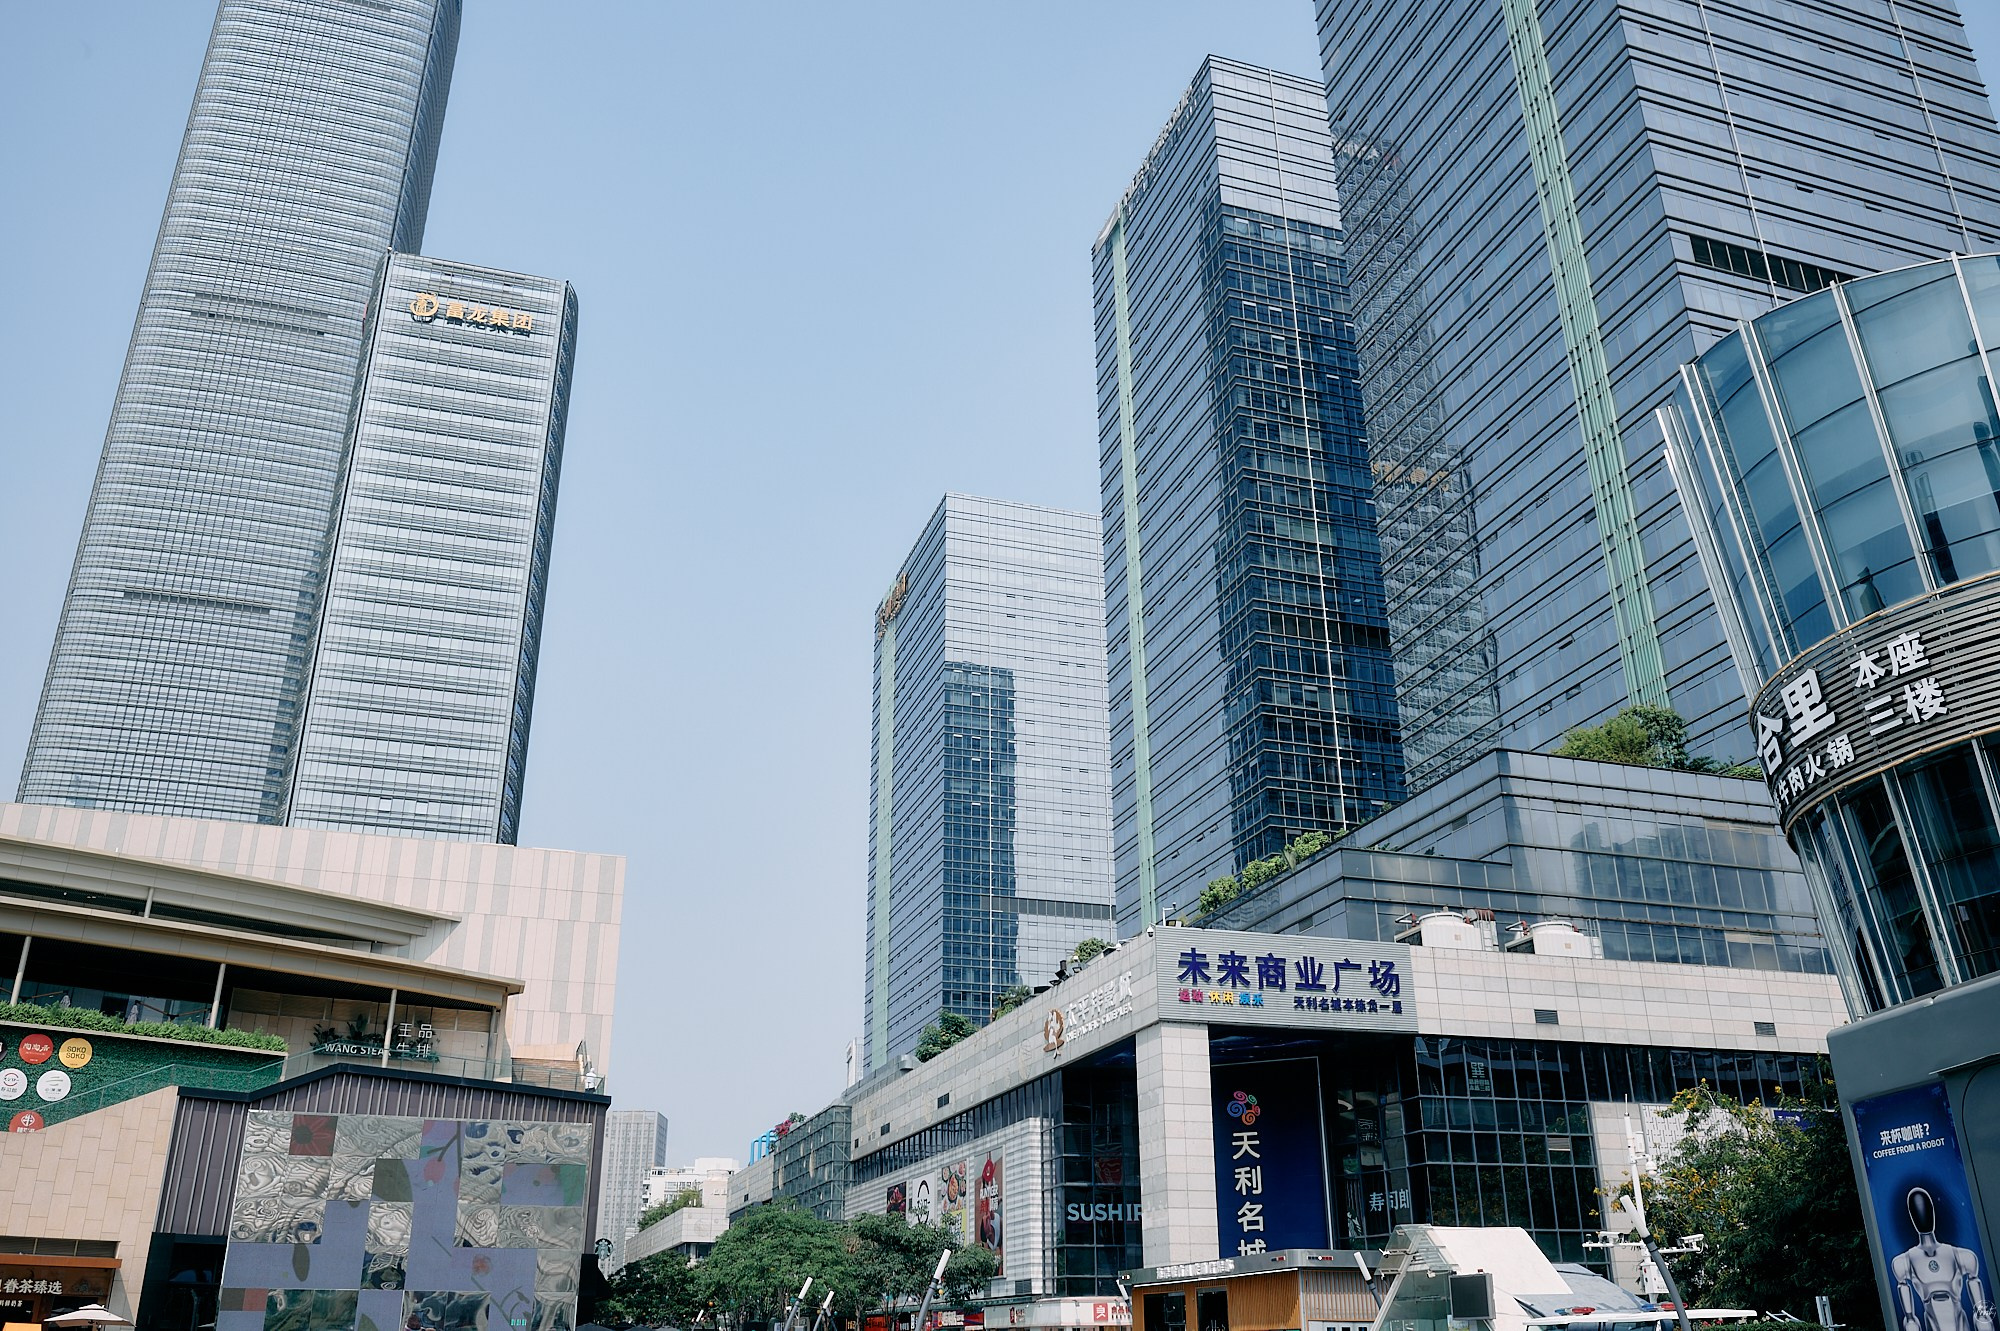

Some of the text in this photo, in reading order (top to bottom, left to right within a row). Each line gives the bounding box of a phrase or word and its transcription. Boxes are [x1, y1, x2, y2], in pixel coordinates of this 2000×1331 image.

[446, 301, 533, 331] 富龙集团
[1850, 630, 1930, 689] 本座
[1864, 676, 1948, 736] 三楼
[1177, 947, 1402, 997] 未来商业广场
[1178, 987, 1264, 1007] 运动 休闲 娱乐
[398, 1022, 432, 1039] 王品
[325, 1043, 357, 1054] WANG
[396, 1042, 431, 1058] 牛排
[1880, 1123, 1930, 1146] 来杯咖啡?
[1873, 1138, 1945, 1159] COFFEE FROM A ROBOT
[1231, 1131, 1267, 1256] 天利名城
[1369, 1189, 1411, 1212] 寿司郎
[0, 1278, 63, 1295] 眷茶臻选
